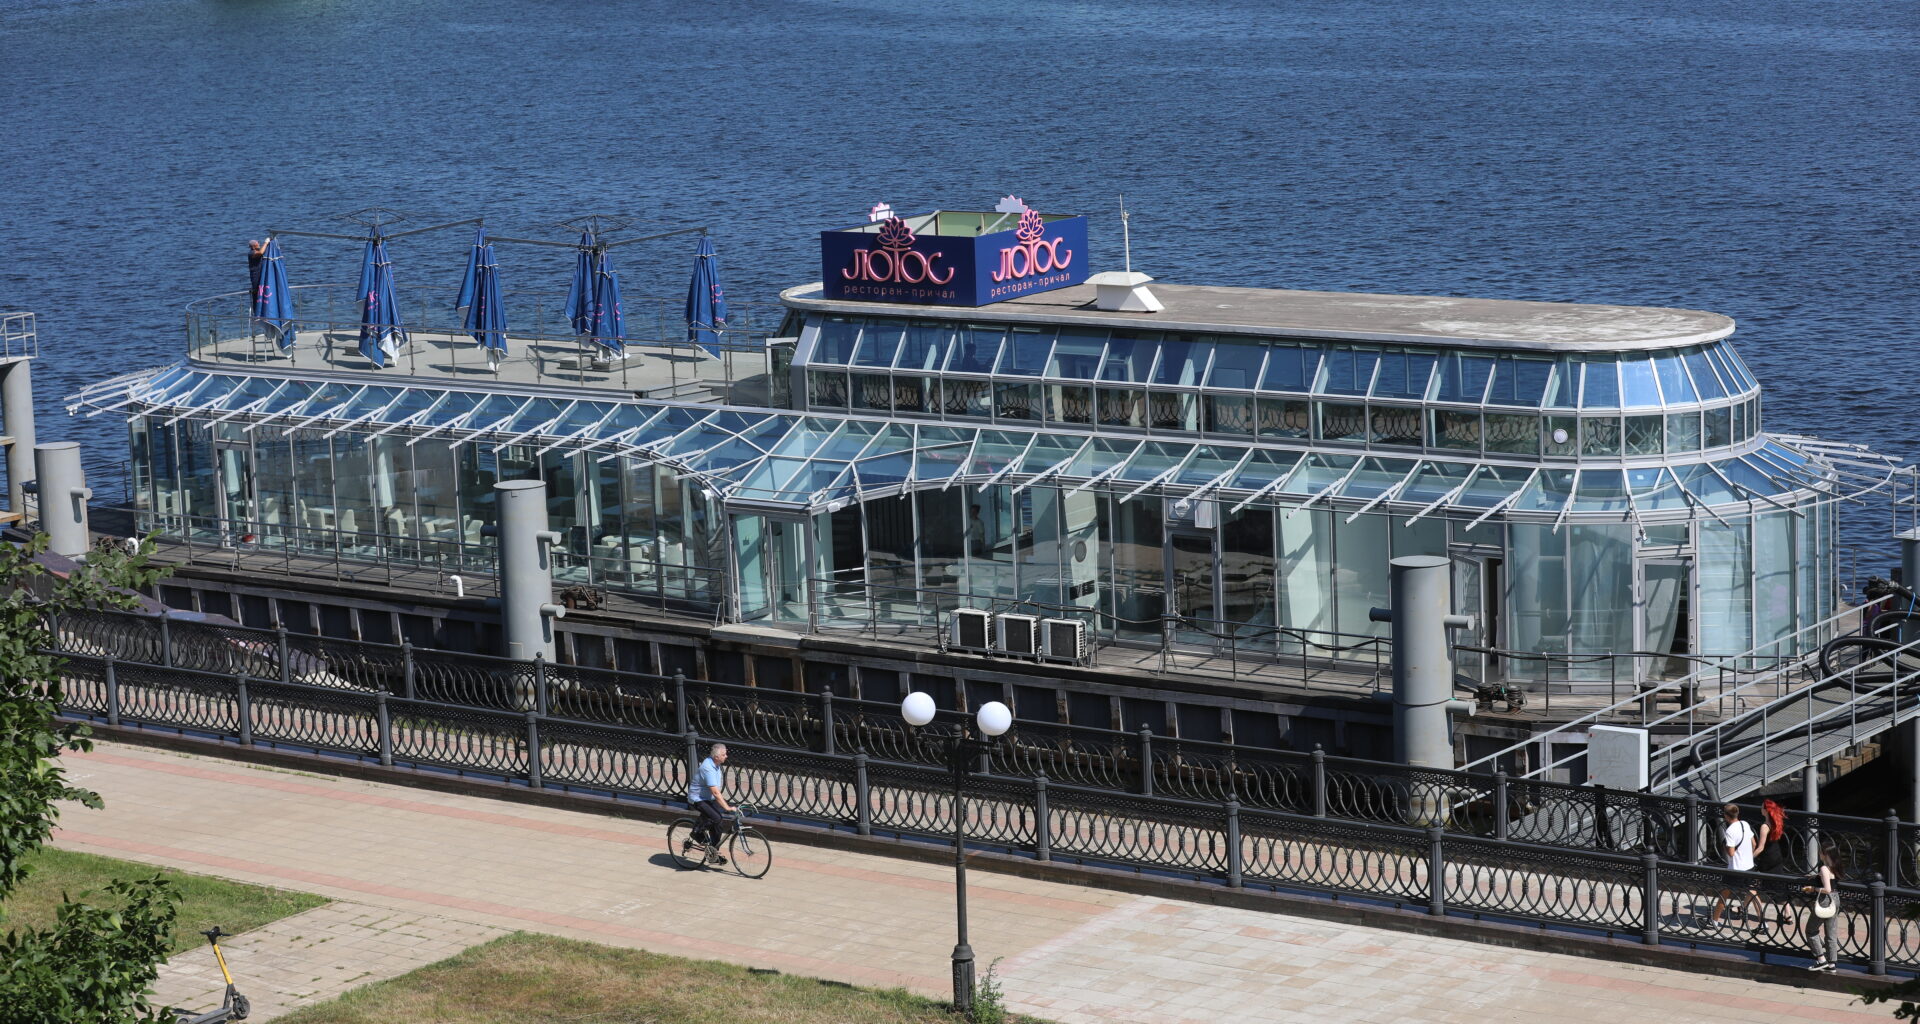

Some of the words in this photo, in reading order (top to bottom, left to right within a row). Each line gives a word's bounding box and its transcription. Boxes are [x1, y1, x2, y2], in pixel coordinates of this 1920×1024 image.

[842, 246, 954, 284] ЛОТОС
[991, 237, 1072, 282] ЛОТОС
[844, 285, 955, 299] ресторан-причал
[991, 272, 1070, 298] ресторан-причал
